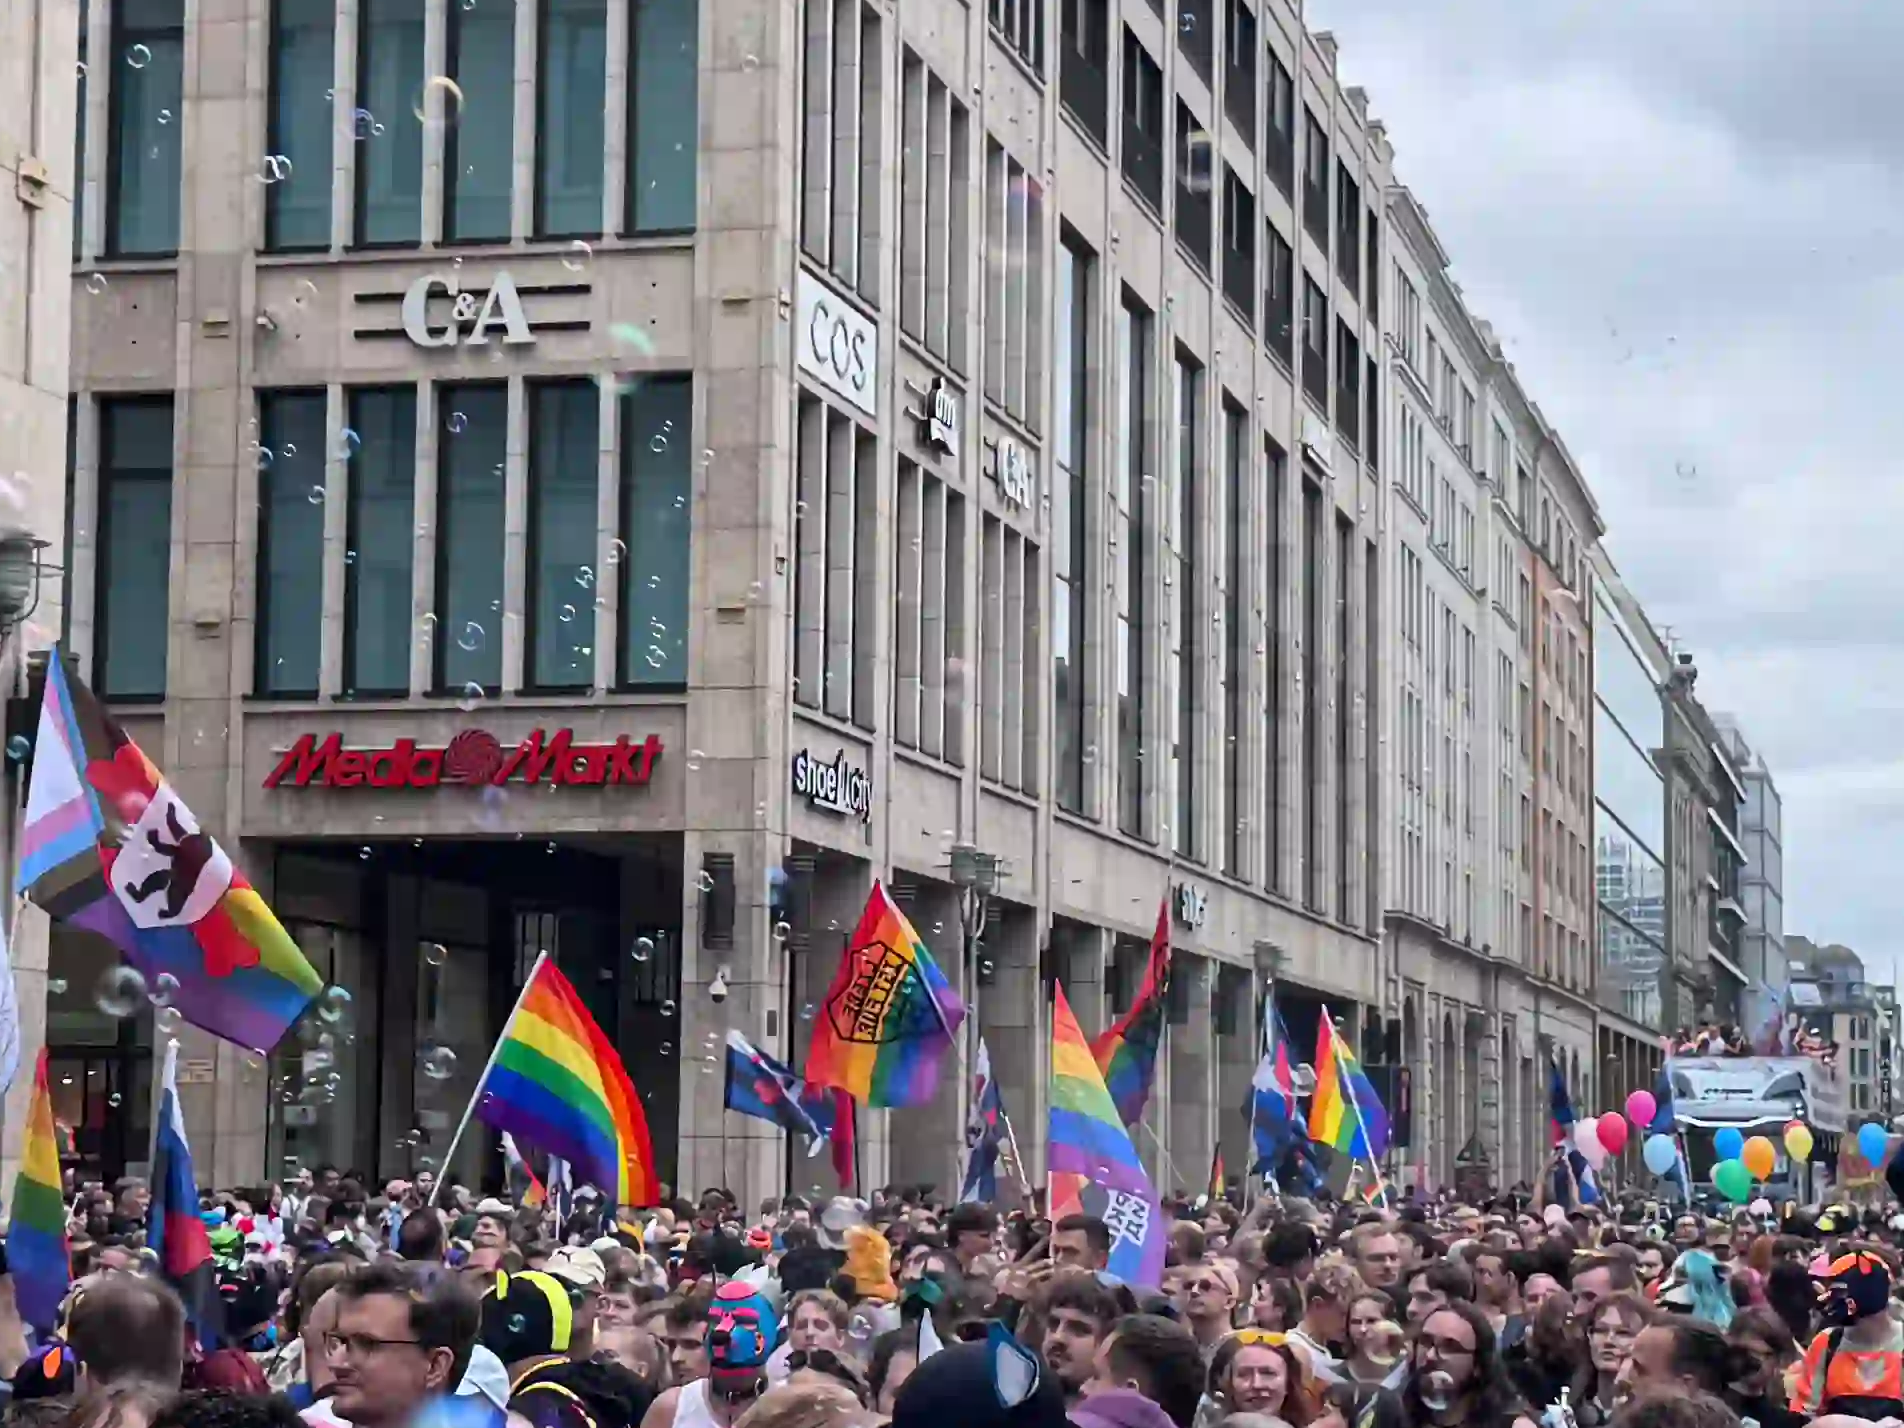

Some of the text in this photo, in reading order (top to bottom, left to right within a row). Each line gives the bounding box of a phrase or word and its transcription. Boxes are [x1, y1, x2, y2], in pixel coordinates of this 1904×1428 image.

[401, 270, 538, 347] C&A
[810, 298, 866, 392] COS
[495, 727, 665, 786] Markt
